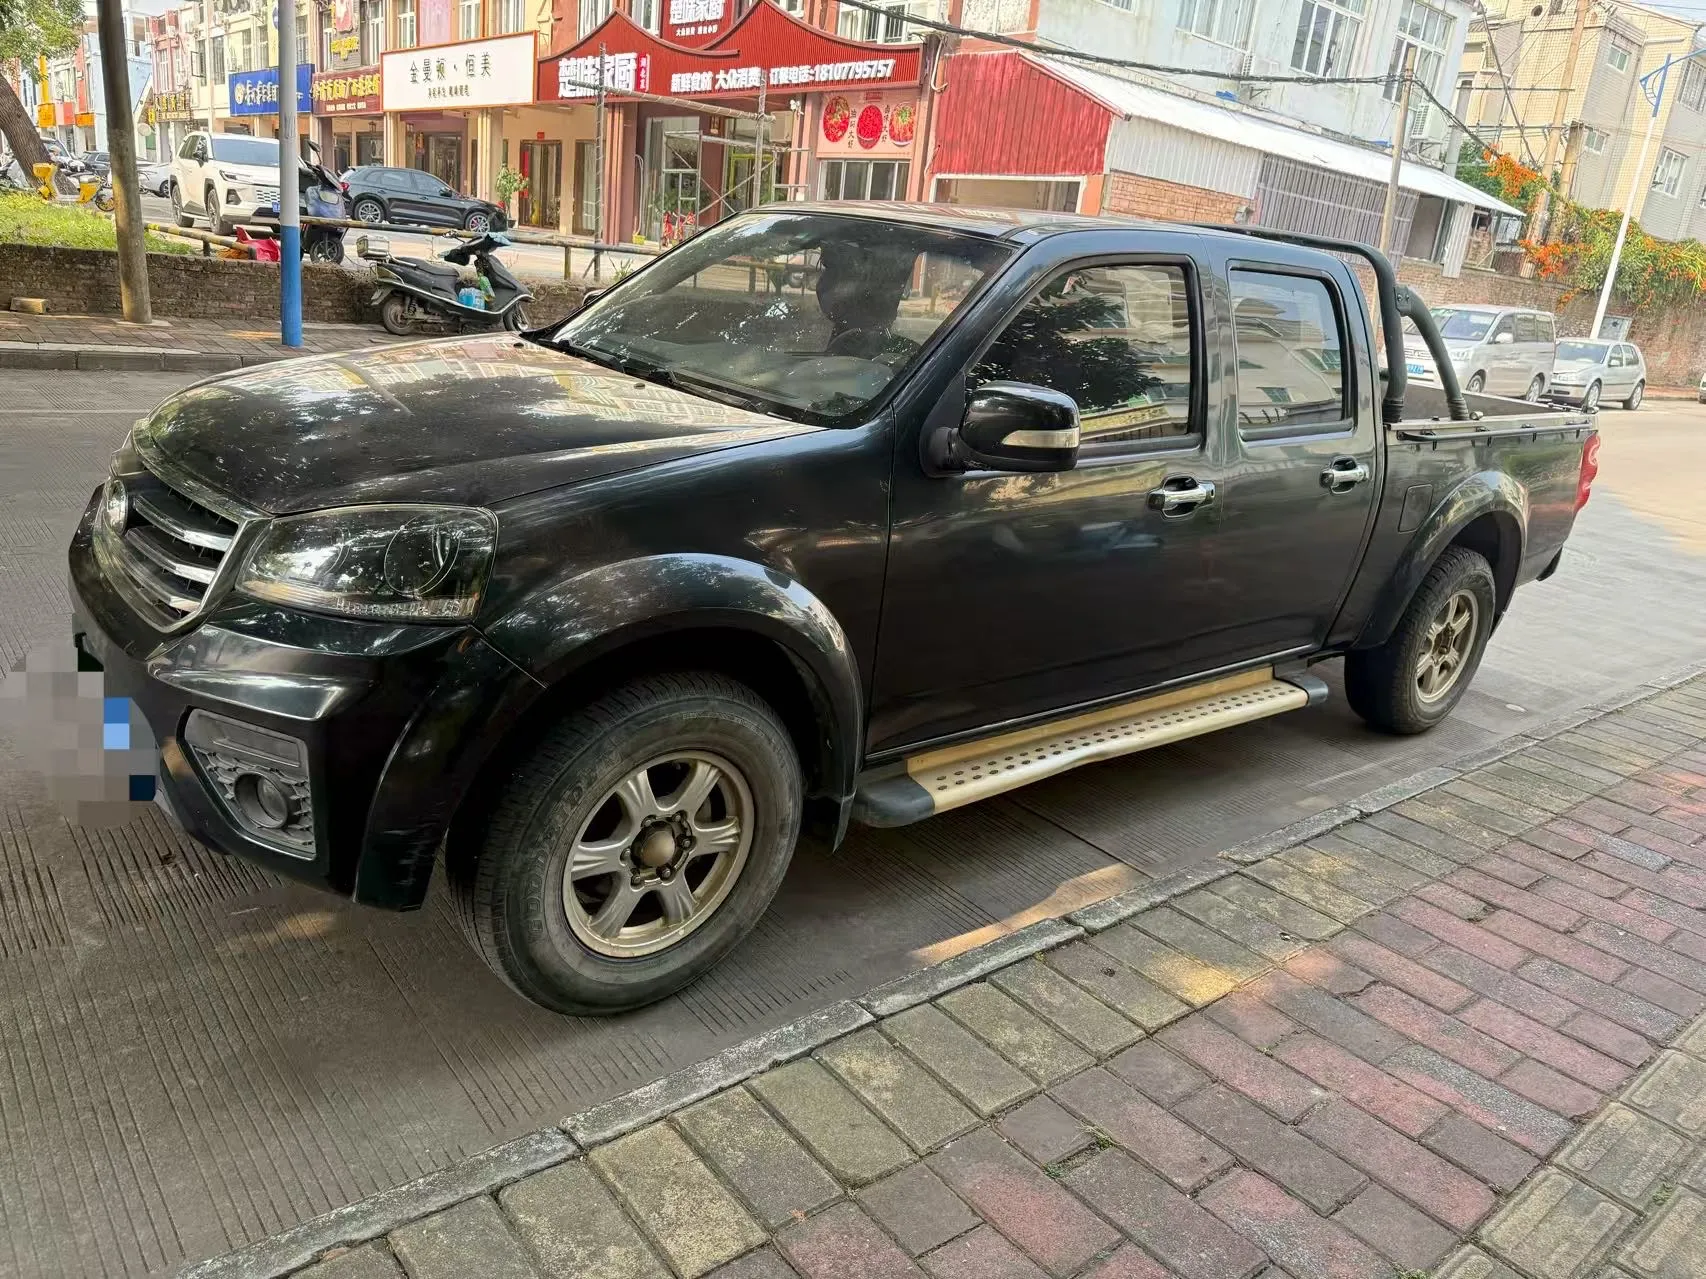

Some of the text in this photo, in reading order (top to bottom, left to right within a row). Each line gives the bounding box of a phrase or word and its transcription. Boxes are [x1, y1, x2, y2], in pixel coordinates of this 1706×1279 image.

[671, 71, 713, 93] 新鲜食材
[715, 67, 762, 90] 大众消费
